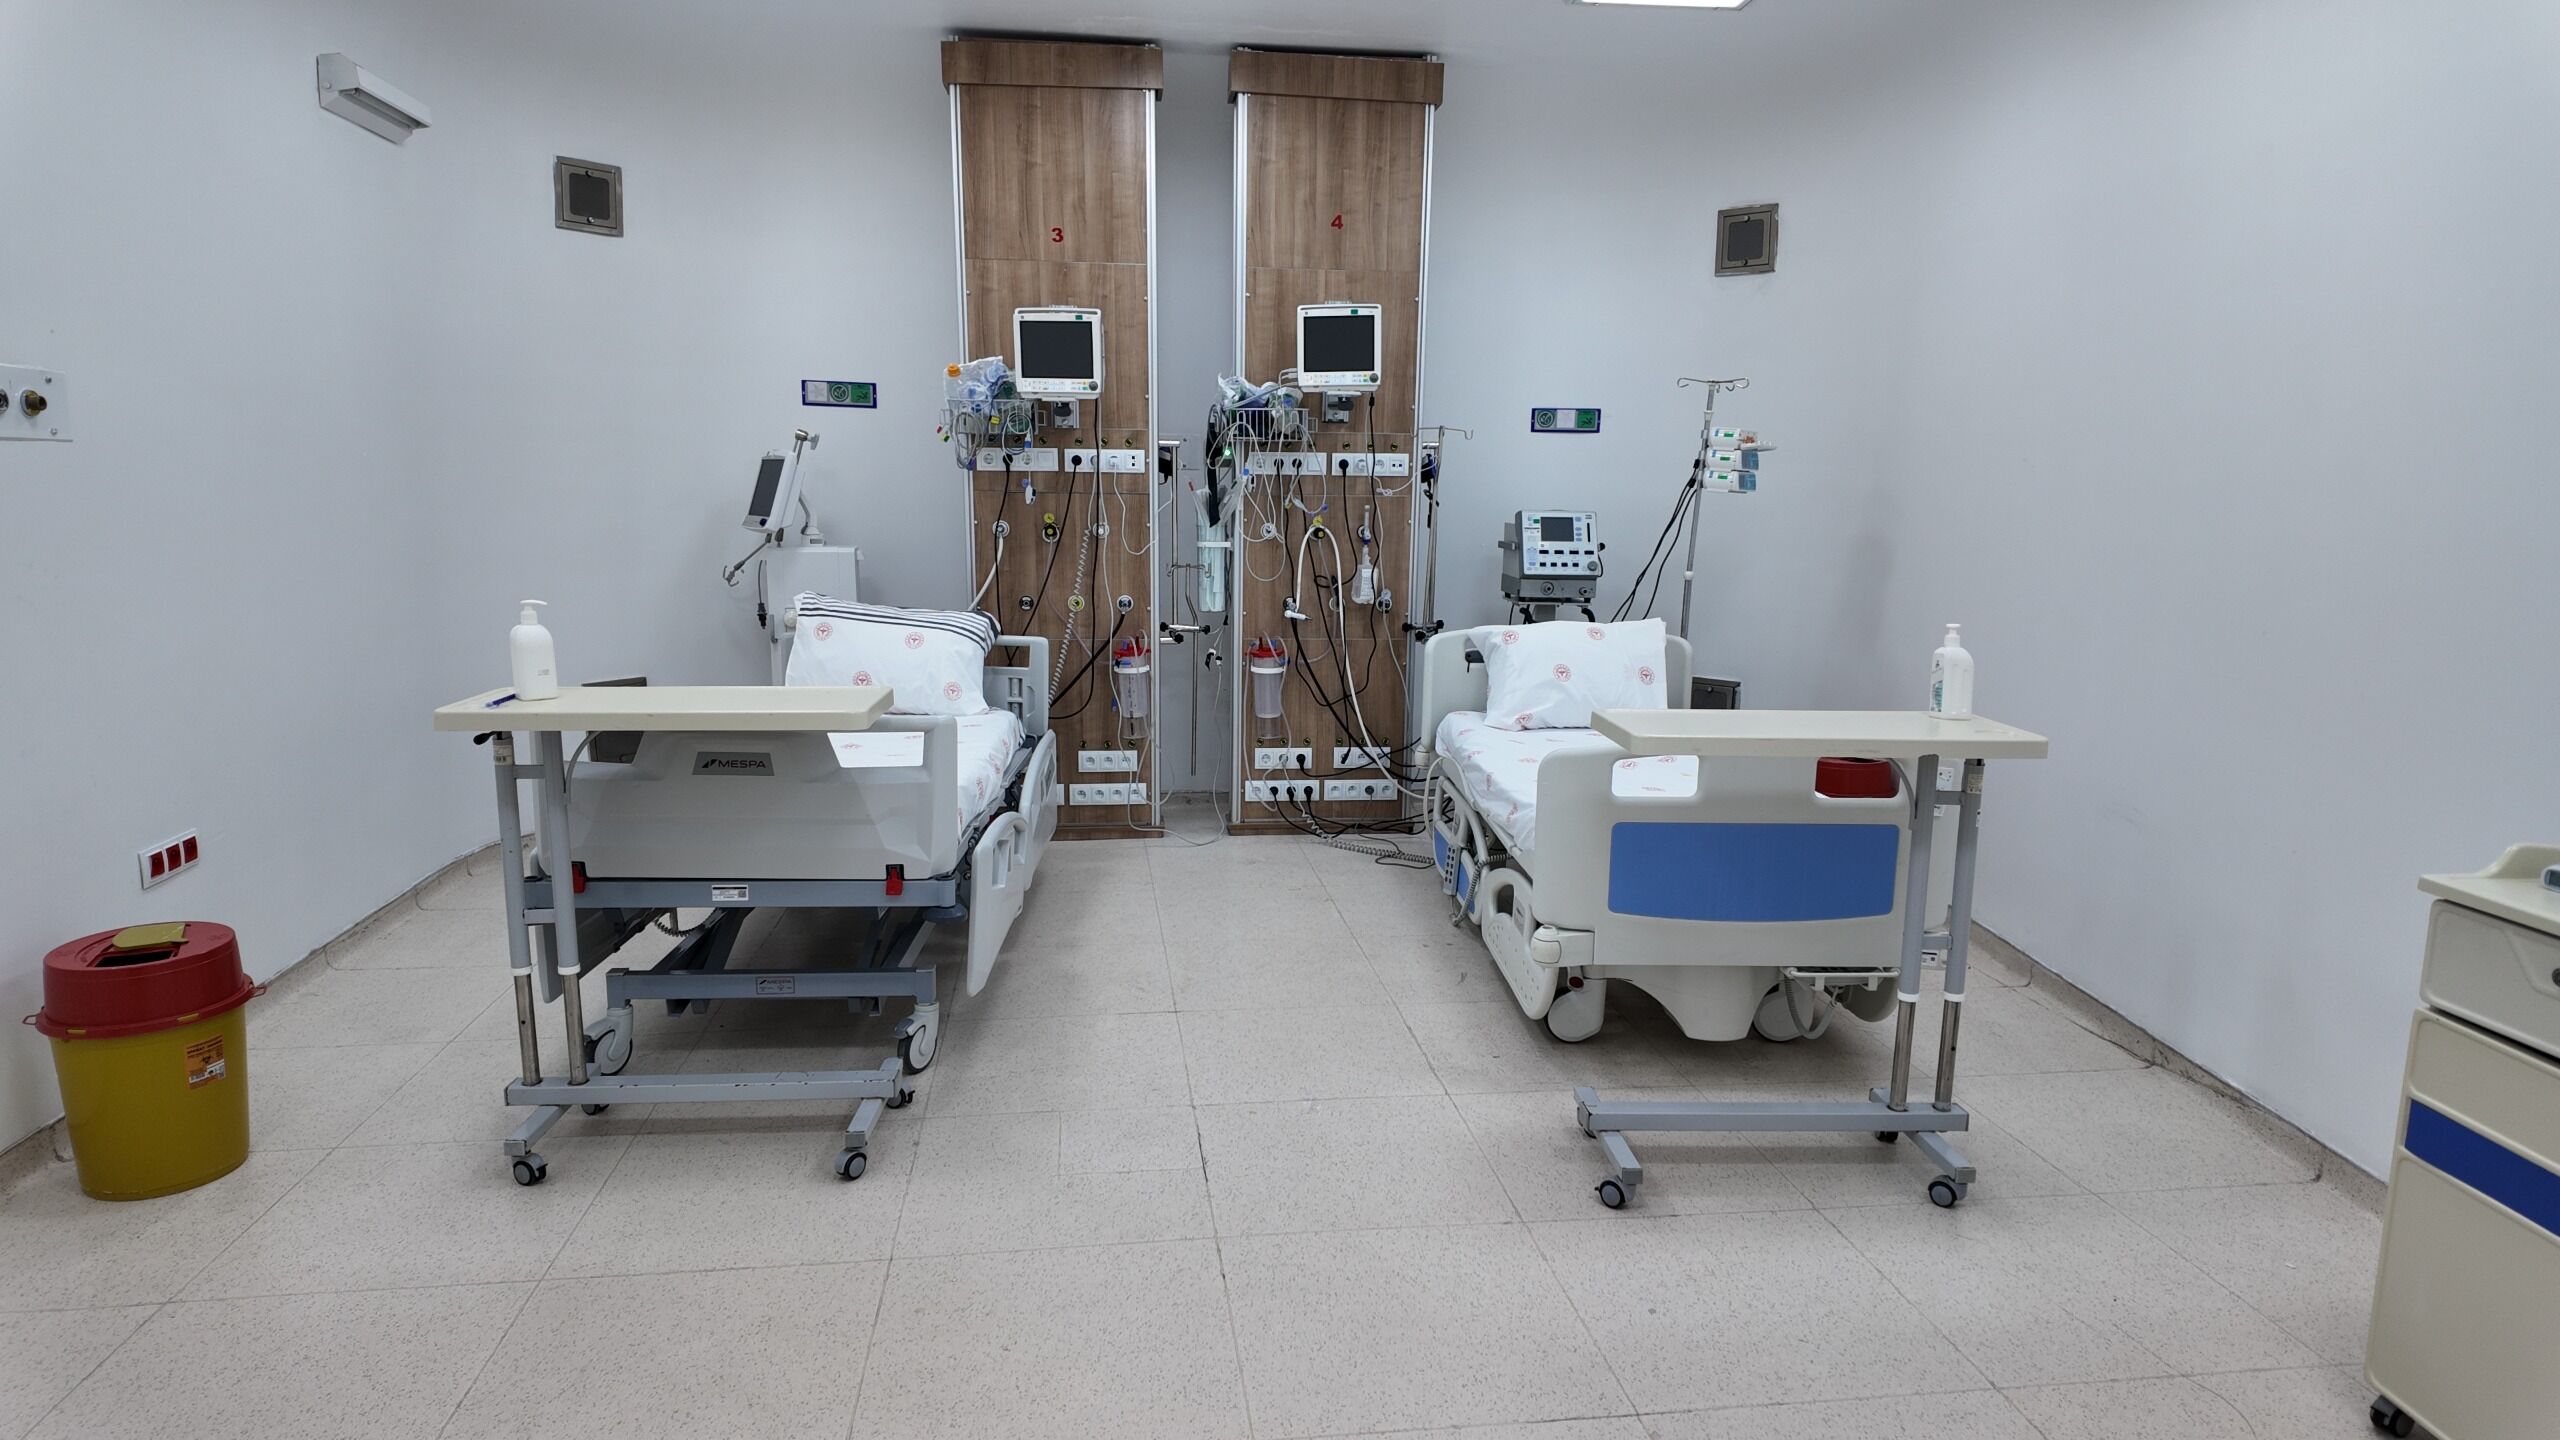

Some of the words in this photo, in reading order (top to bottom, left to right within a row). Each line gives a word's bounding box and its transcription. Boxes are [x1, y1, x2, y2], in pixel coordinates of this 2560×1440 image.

[1330, 214, 1344, 230] 4
[1051, 226, 1064, 243] 3
[718, 759, 767, 769] MESPA
